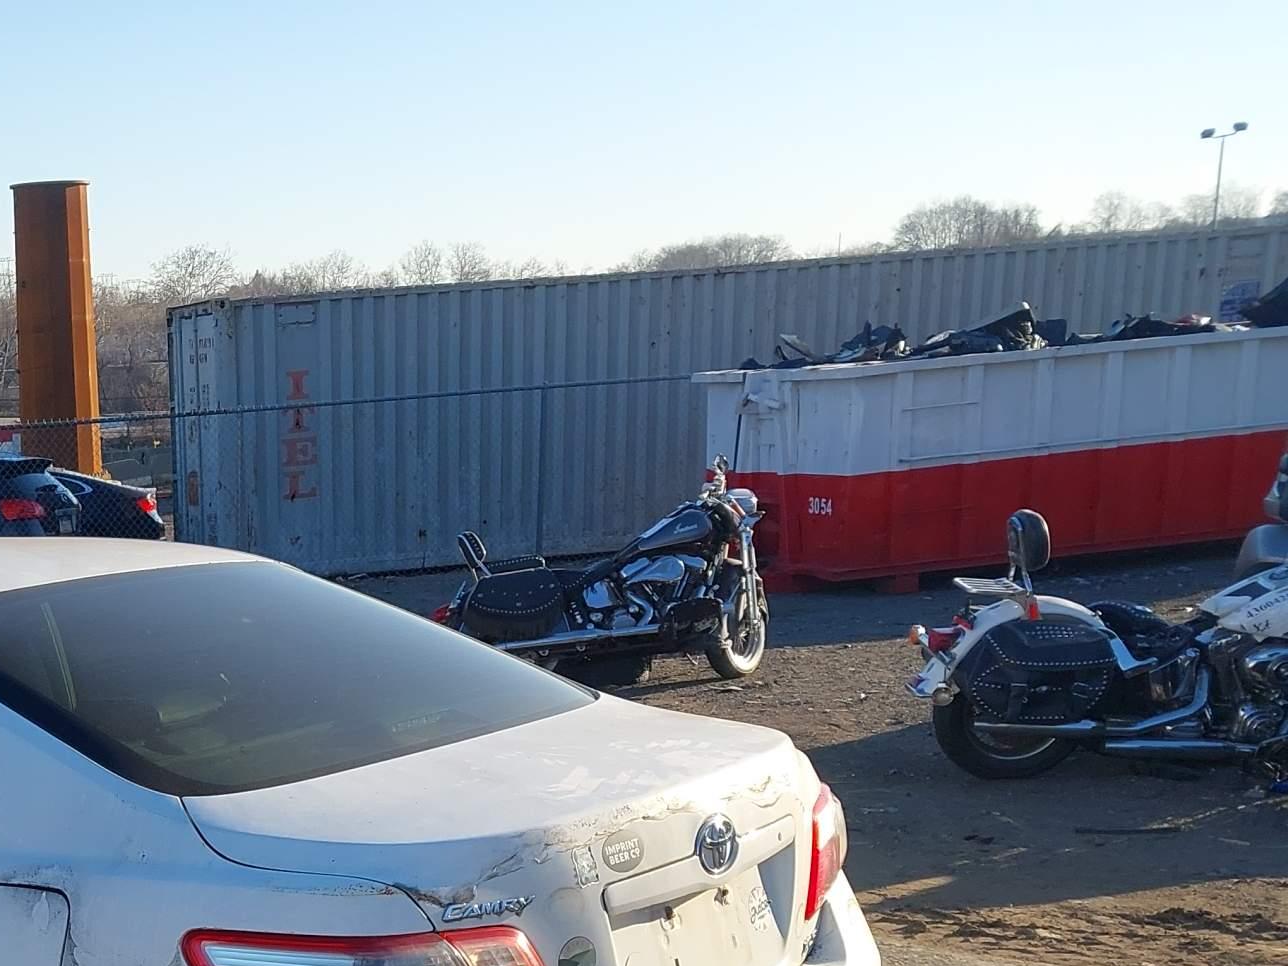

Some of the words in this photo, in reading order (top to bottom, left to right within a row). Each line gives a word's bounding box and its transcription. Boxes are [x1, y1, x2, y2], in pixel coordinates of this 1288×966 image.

[279, 368, 318, 500] ITEL
[808, 496, 832, 516] 3054
[605, 838, 639, 856] IMPRINT
[609, 851, 631, 865] BEER
[442, 895, 536, 921] CAMRY
